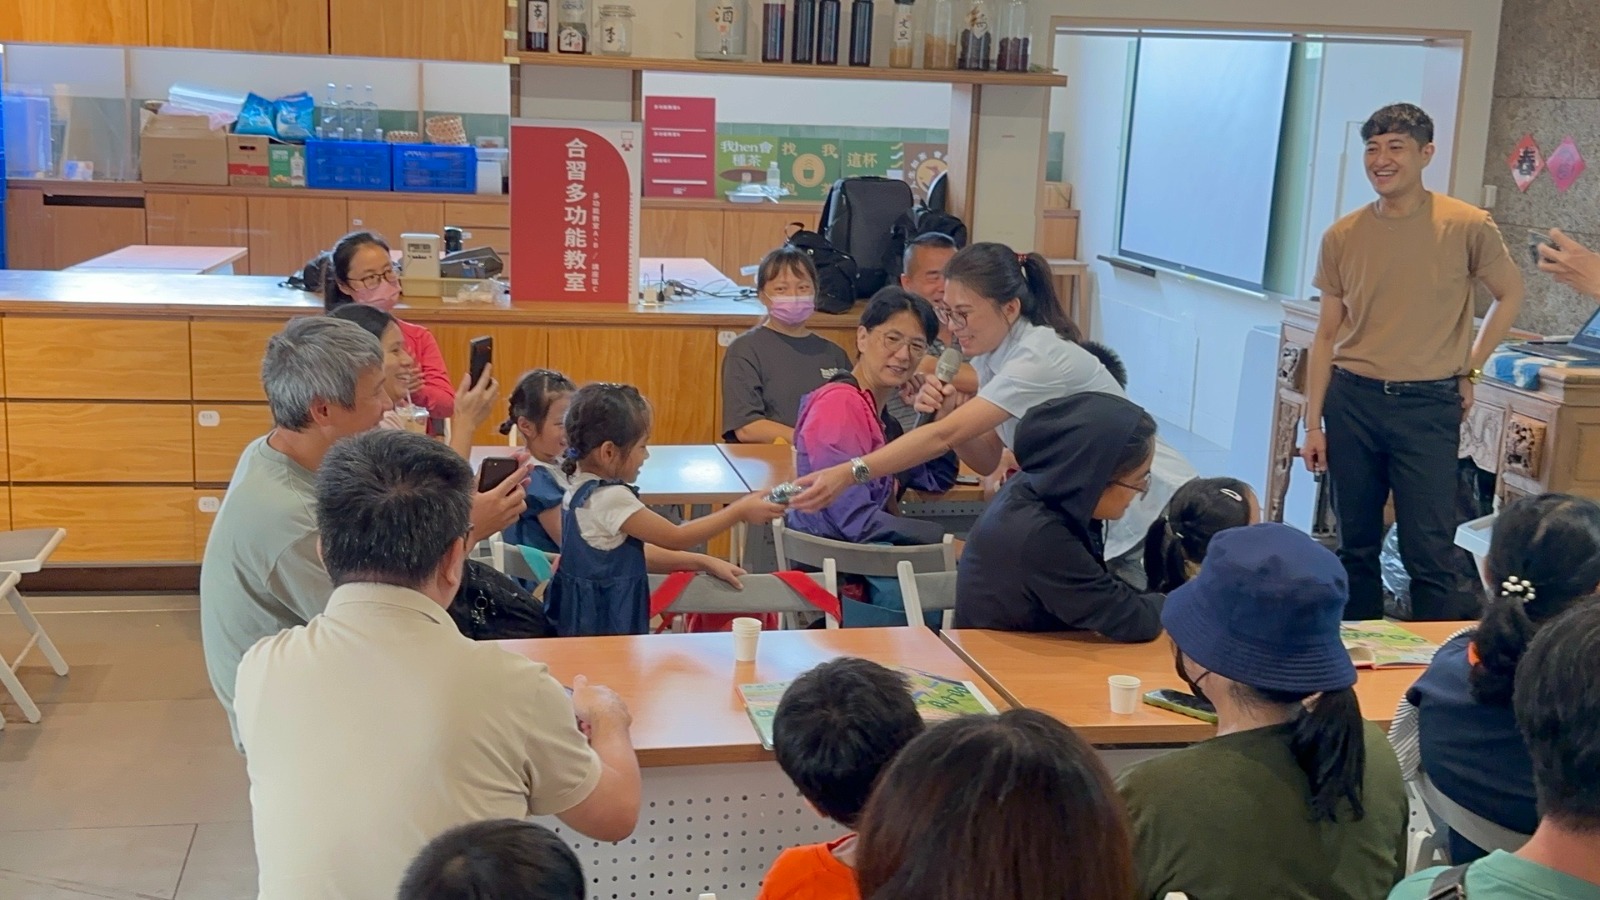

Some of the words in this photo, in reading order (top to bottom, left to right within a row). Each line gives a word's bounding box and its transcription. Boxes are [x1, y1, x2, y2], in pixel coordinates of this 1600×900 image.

[714, 6, 734, 24] 酒
[720, 139, 774, 154] 我hen會
[732, 154, 762, 168] 種茶
[846, 152, 878, 168] 這杯
[1515, 147, 1536, 176] 春
[564, 138, 588, 292] 合習多功能教室
